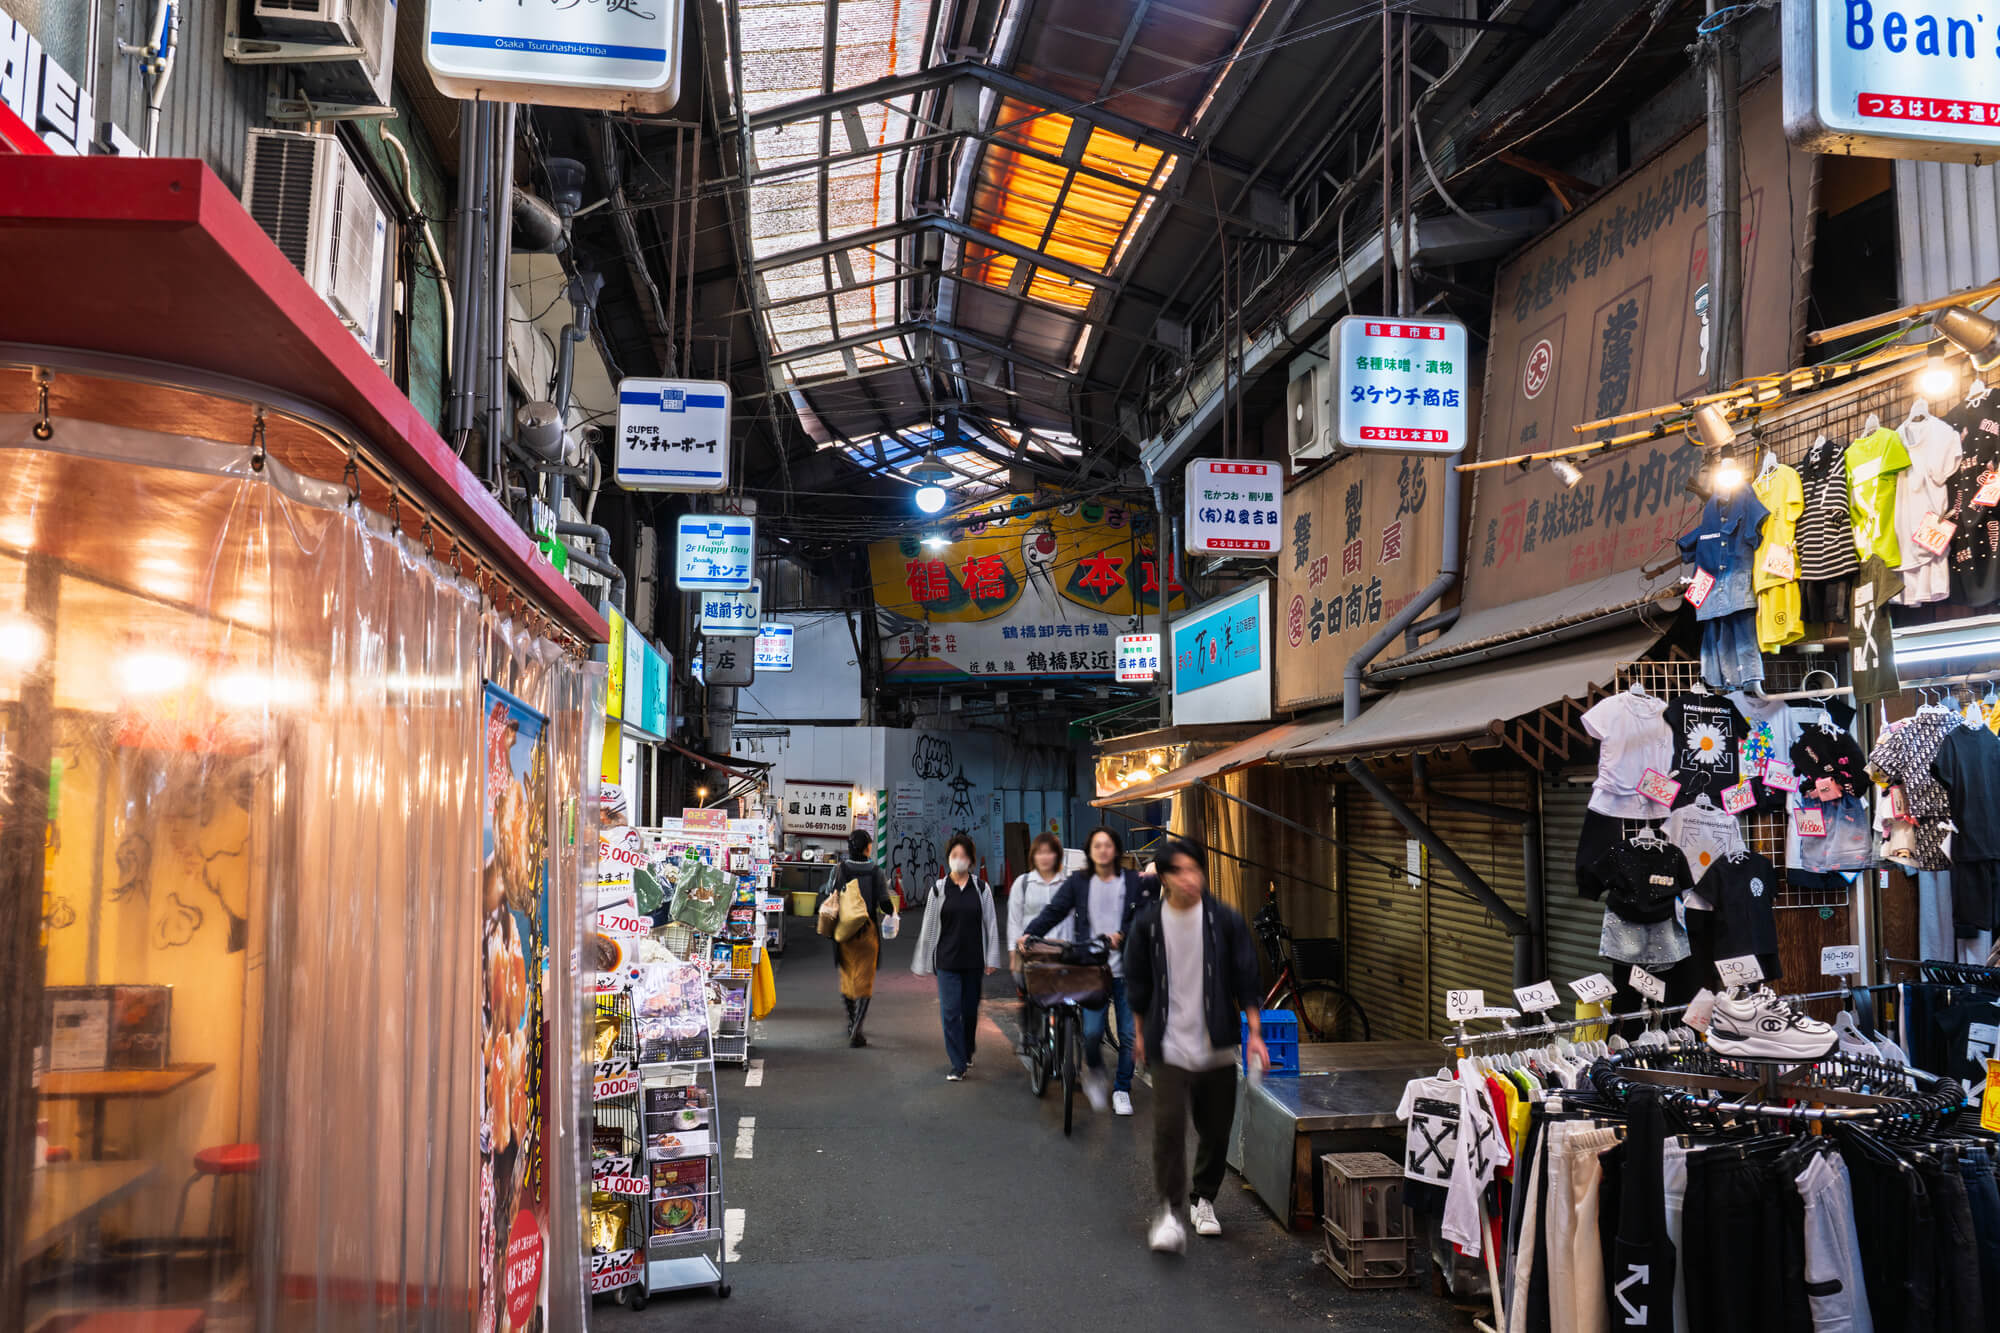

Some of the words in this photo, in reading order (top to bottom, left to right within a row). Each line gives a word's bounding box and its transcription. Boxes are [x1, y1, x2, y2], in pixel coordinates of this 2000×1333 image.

[495, 39, 524, 49] Osaka
[1868, 98, 2000, 123] つるはし本通り
[1350, 385, 1459, 407] タケウチ商店
[627, 425, 659, 434] SUPER
[1366, 429, 1443, 440] つるはし本通り
[685, 544, 696, 552] 2F
[697, 545, 728, 554] Happy
[730, 545, 749, 554] Day
[906, 553, 1006, 602] 鶴橋
[1307, 575, 1382, 643] 吉田商店
[1002, 623, 1109, 640] 鶴橋卸売市場
[1026, 651, 1116, 672] 鶴橋駅近
[598, 914, 648, 934] 1,700円
[1633, 967, 1655, 986] 120
[1719, 961, 1744, 976] 130
[1576, 980, 1596, 993] 110
[1451, 991, 1468, 1007] 80
[1519, 989, 1542, 1005] 100
[1458, 1005, 1478, 1014] センチ
[601, 1177, 650, 1194] 1,000円
[592, 1253, 634, 1274] ジャン
[591, 1272, 639, 1292] 2,000円
